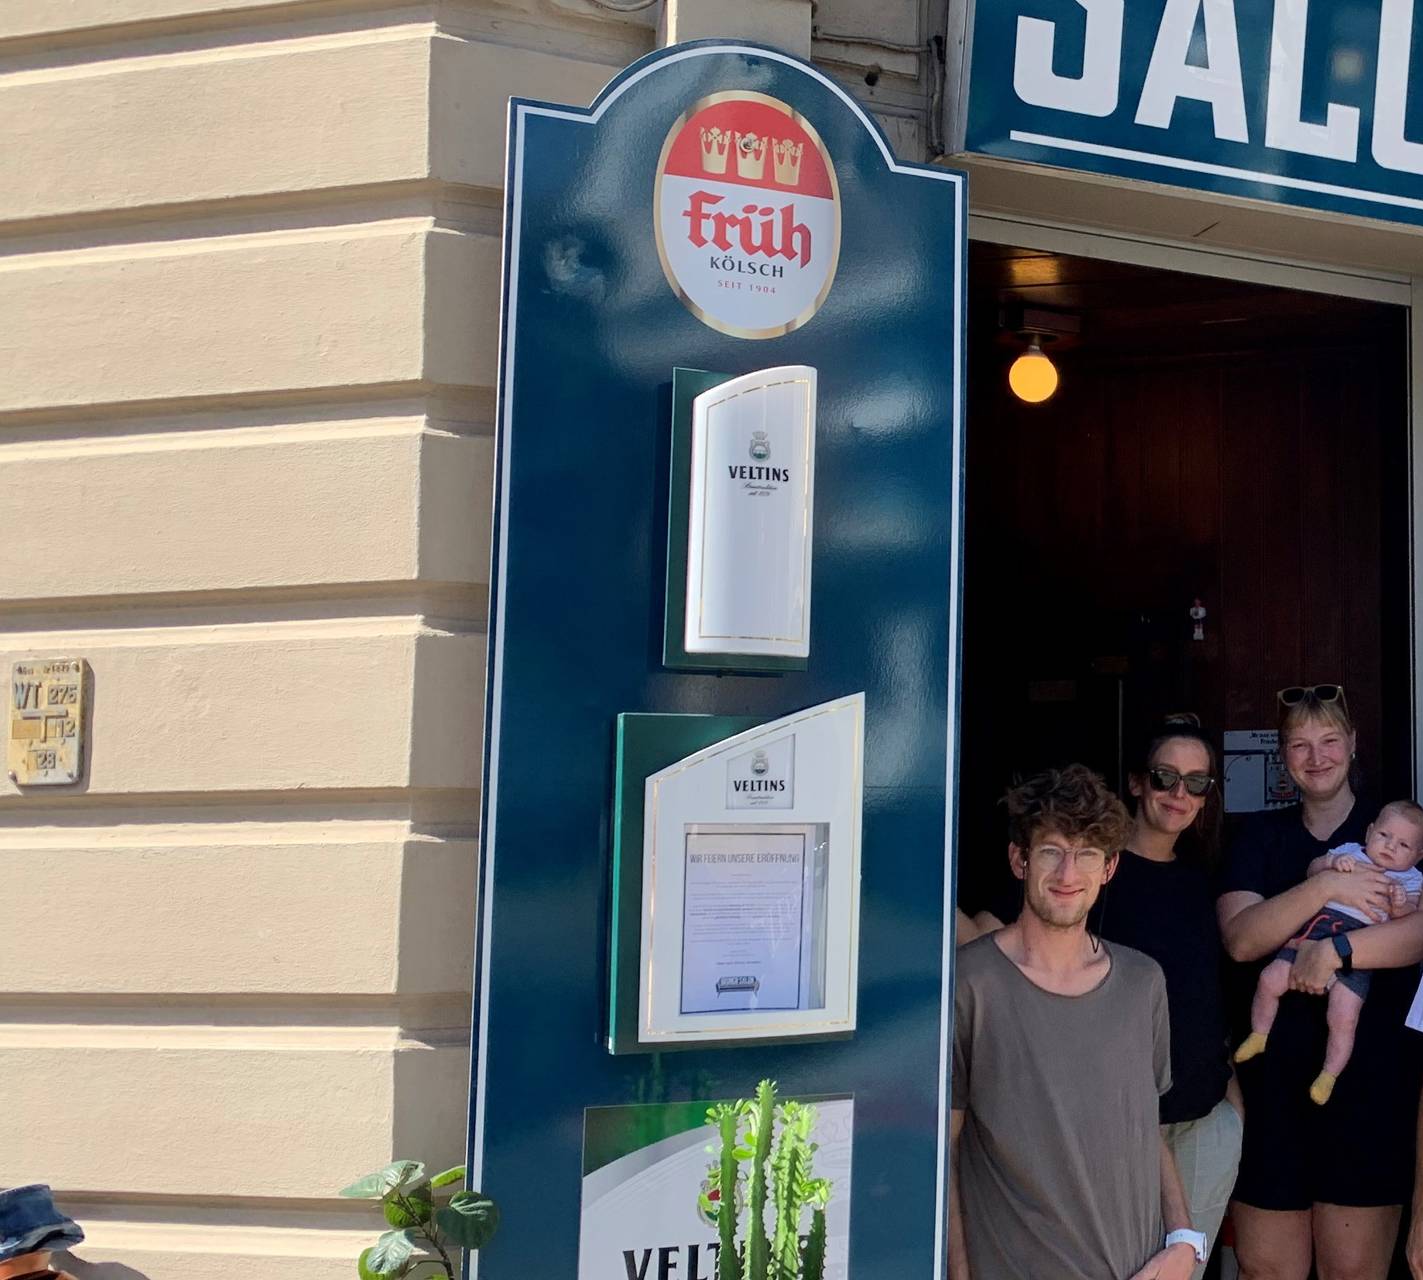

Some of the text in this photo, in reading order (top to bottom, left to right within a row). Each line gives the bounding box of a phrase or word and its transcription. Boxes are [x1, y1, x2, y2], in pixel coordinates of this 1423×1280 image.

[710, 256, 784, 278] KÖLSCH
[717, 279, 742, 289] SEIT
[728, 465, 789, 482] VELTINS
[733, 779, 785, 792] VELTINS
